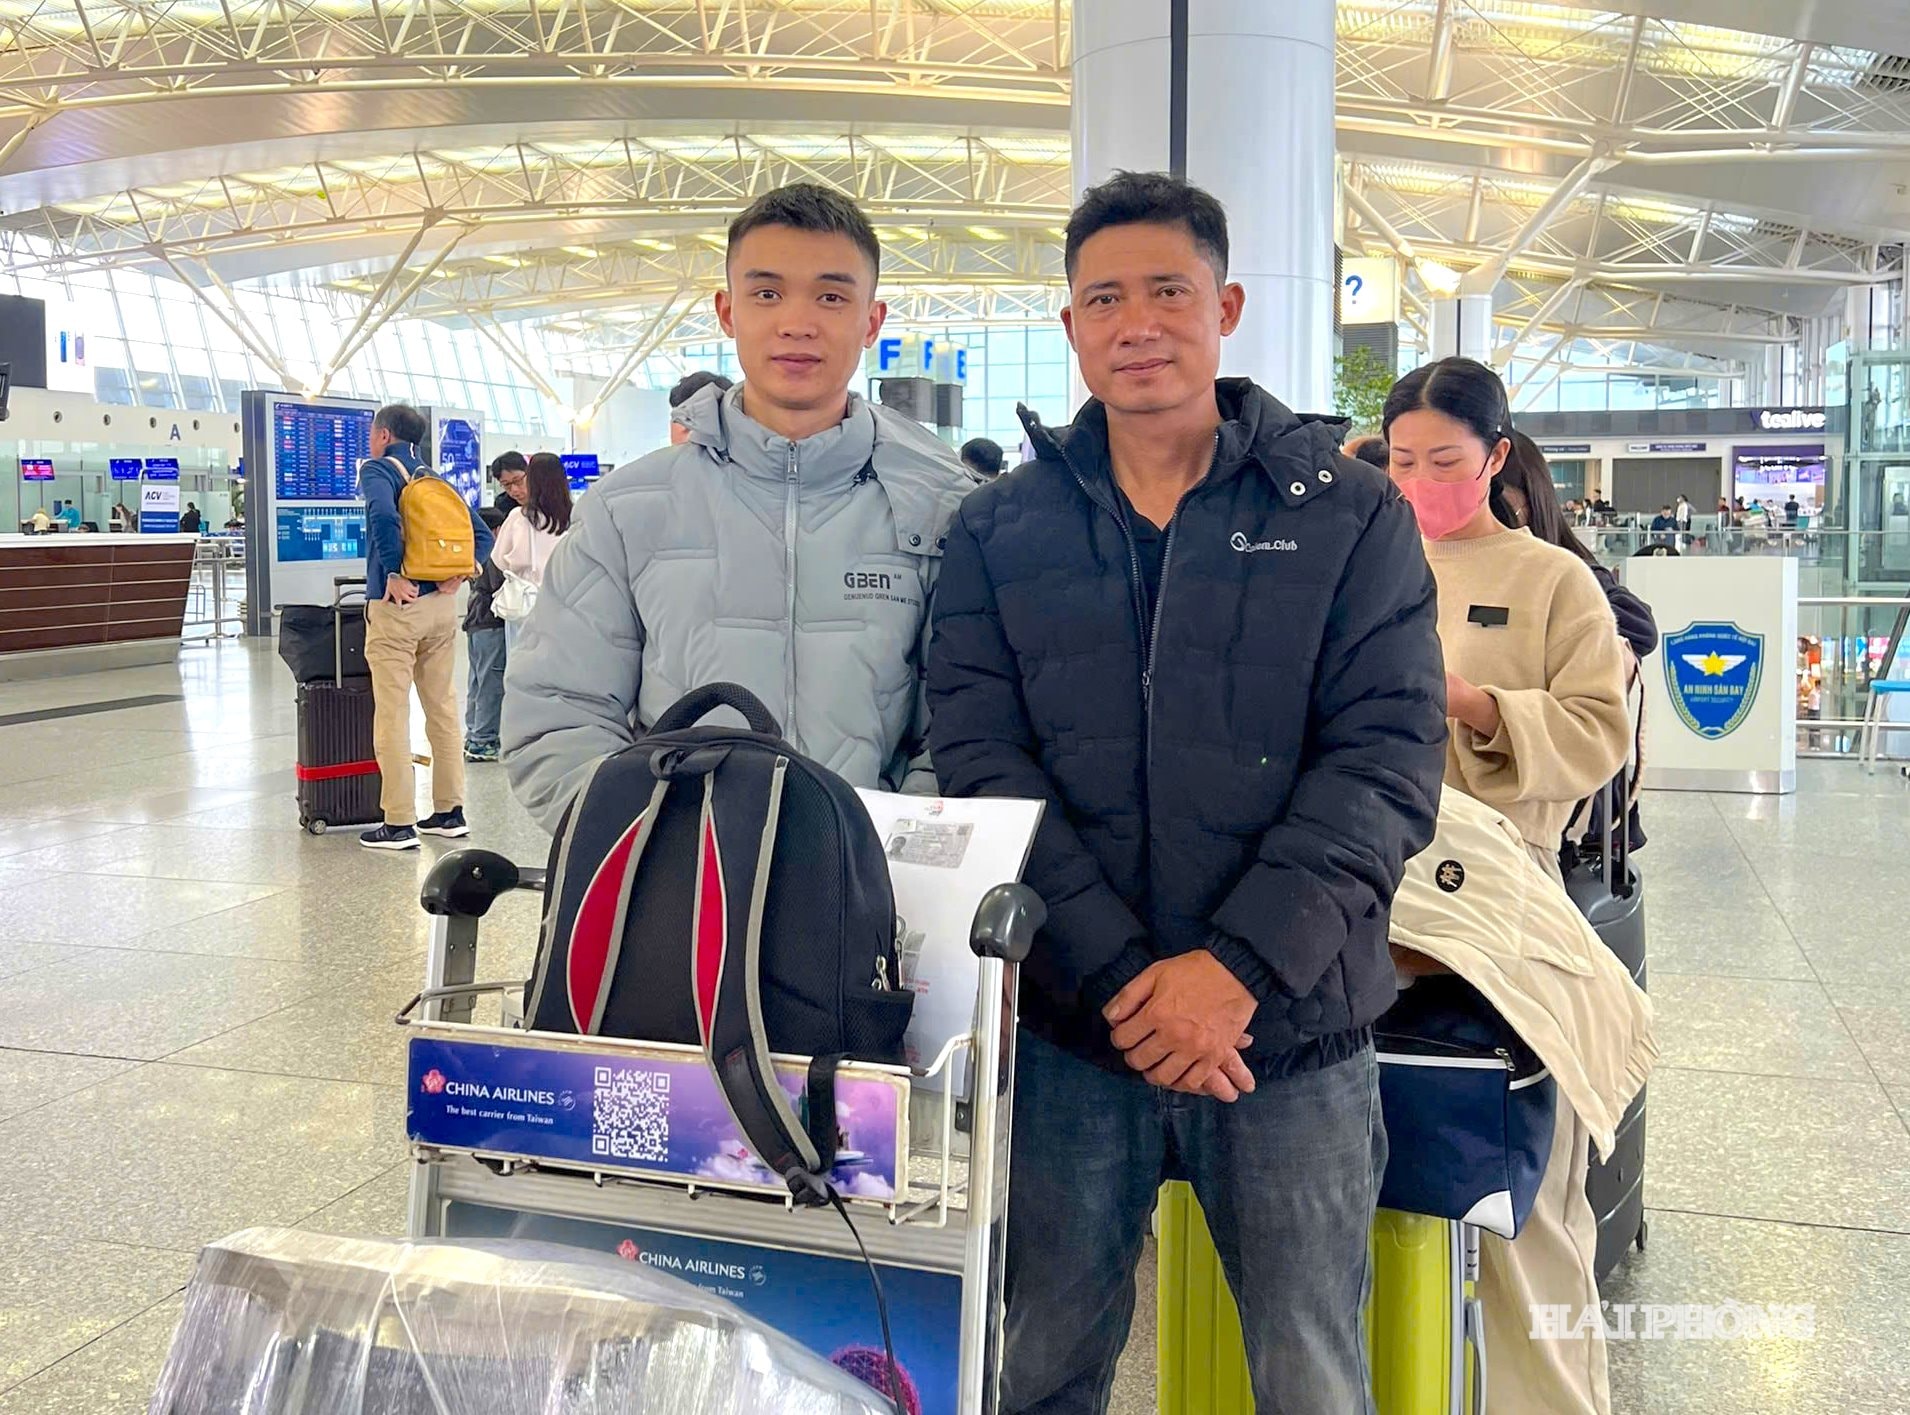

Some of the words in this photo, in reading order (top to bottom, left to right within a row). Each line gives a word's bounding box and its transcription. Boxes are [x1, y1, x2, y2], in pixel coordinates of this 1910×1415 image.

[880, 339, 902, 371] F
[761, 410, 826, 429] tealive
[170, 424, 181, 441] A
[145, 491, 162, 501] ACV
[844, 572, 891, 589] GBEN
[1684, 684, 1693, 695] AN
[445, 1081, 490, 1099] CHINA
[492, 1086, 555, 1105] AIRLINES
[446, 1104, 459, 1114] The
[461, 1106, 477, 1116] best
[479, 1109, 505, 1119] carrier
[507, 1111, 525, 1121] from
[527, 1114, 554, 1125] Taiwan
[639, 1252, 682, 1270] CHINA
[685, 1259, 746, 1280] AIRLINES
[718, 1286, 744, 1298] Taiwan
